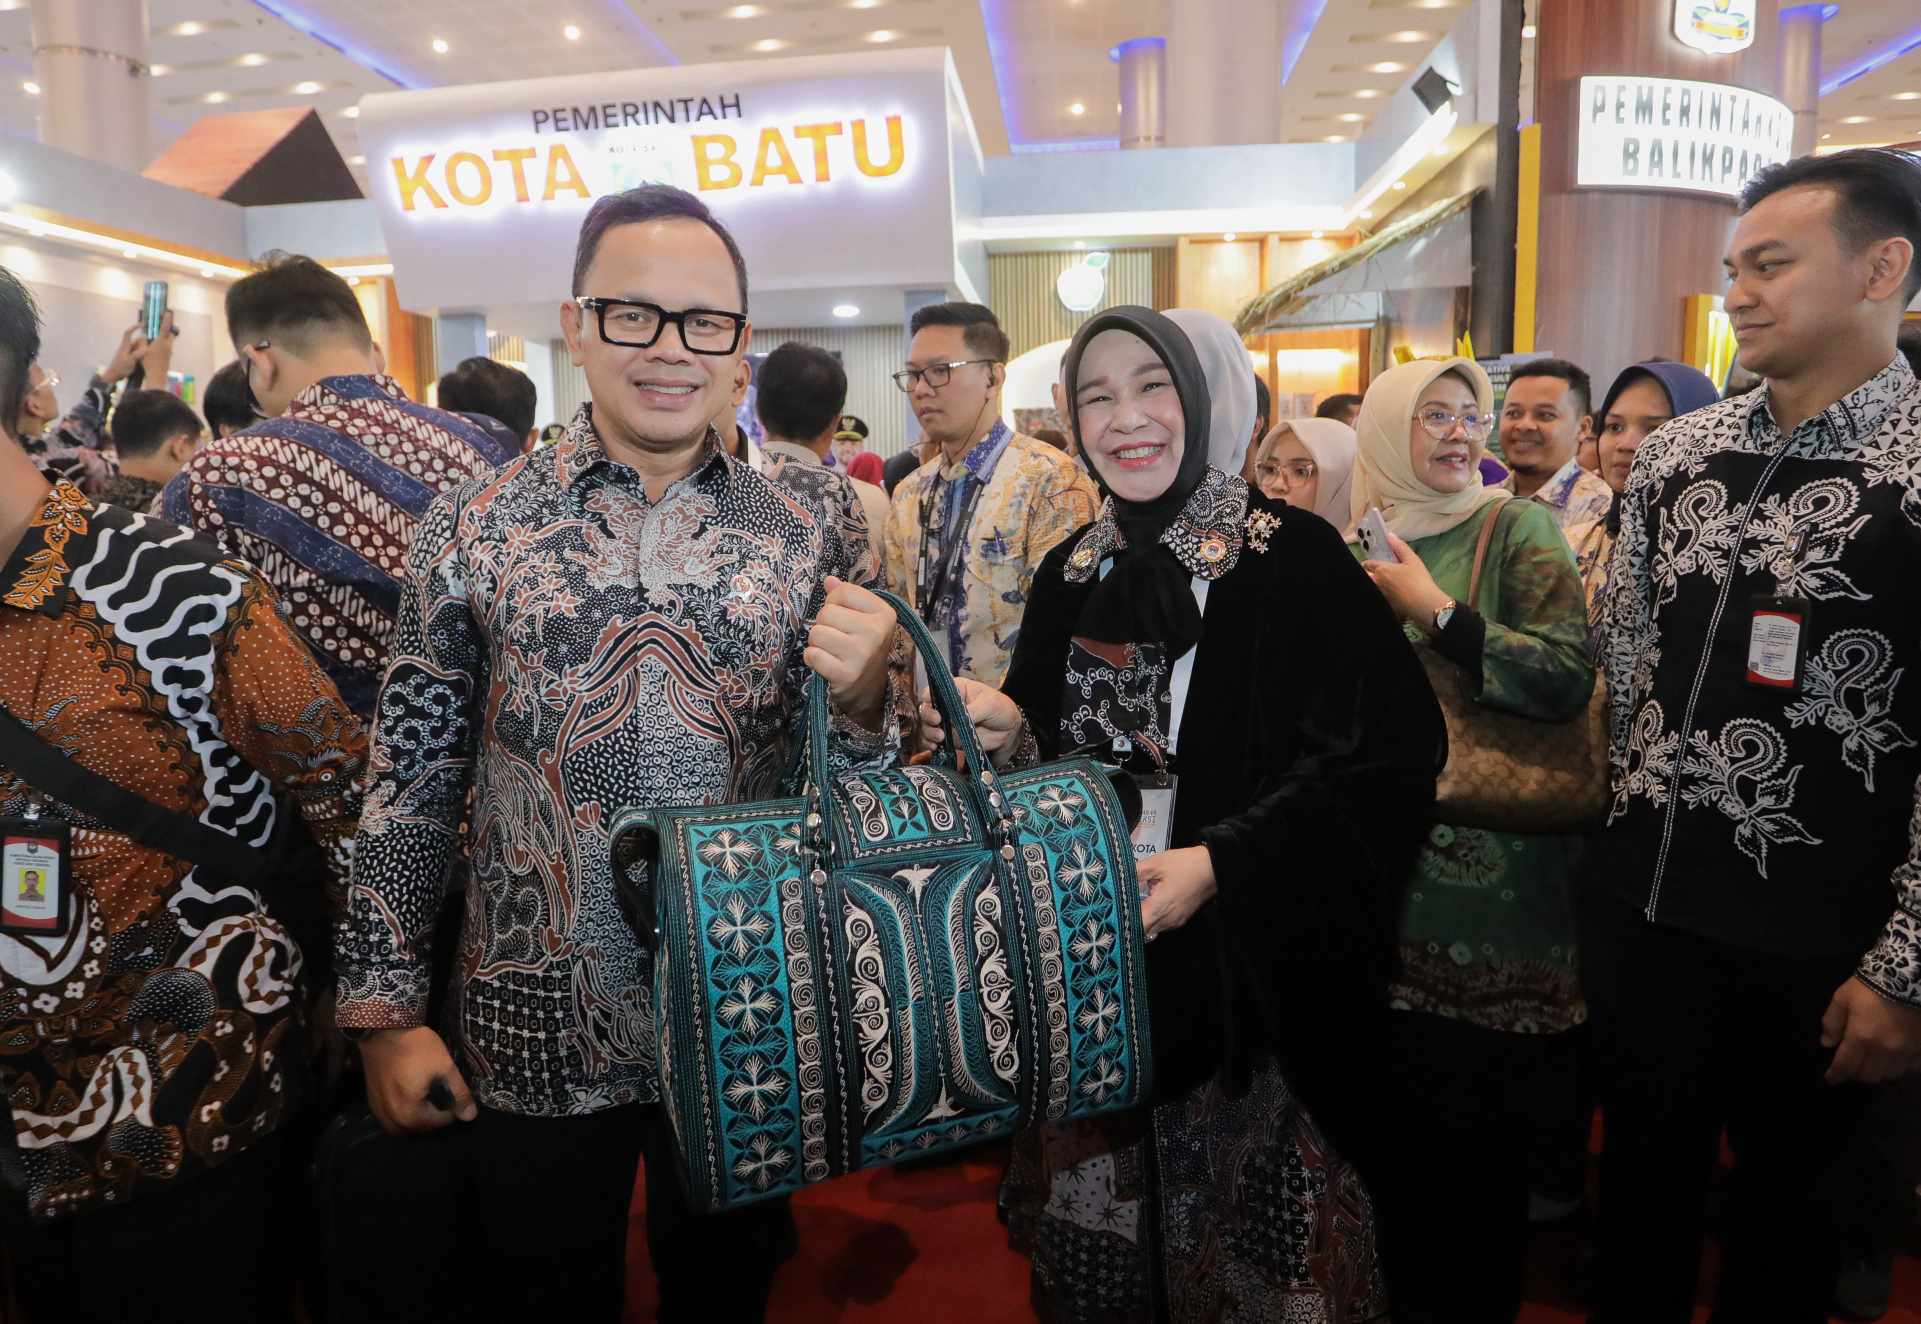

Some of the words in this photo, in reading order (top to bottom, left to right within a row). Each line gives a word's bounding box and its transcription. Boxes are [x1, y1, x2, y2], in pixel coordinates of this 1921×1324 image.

[532, 93, 742, 133] PEMERINTAH
[390, 143, 591, 211] KOTA
[690, 115, 905, 192] BATU
